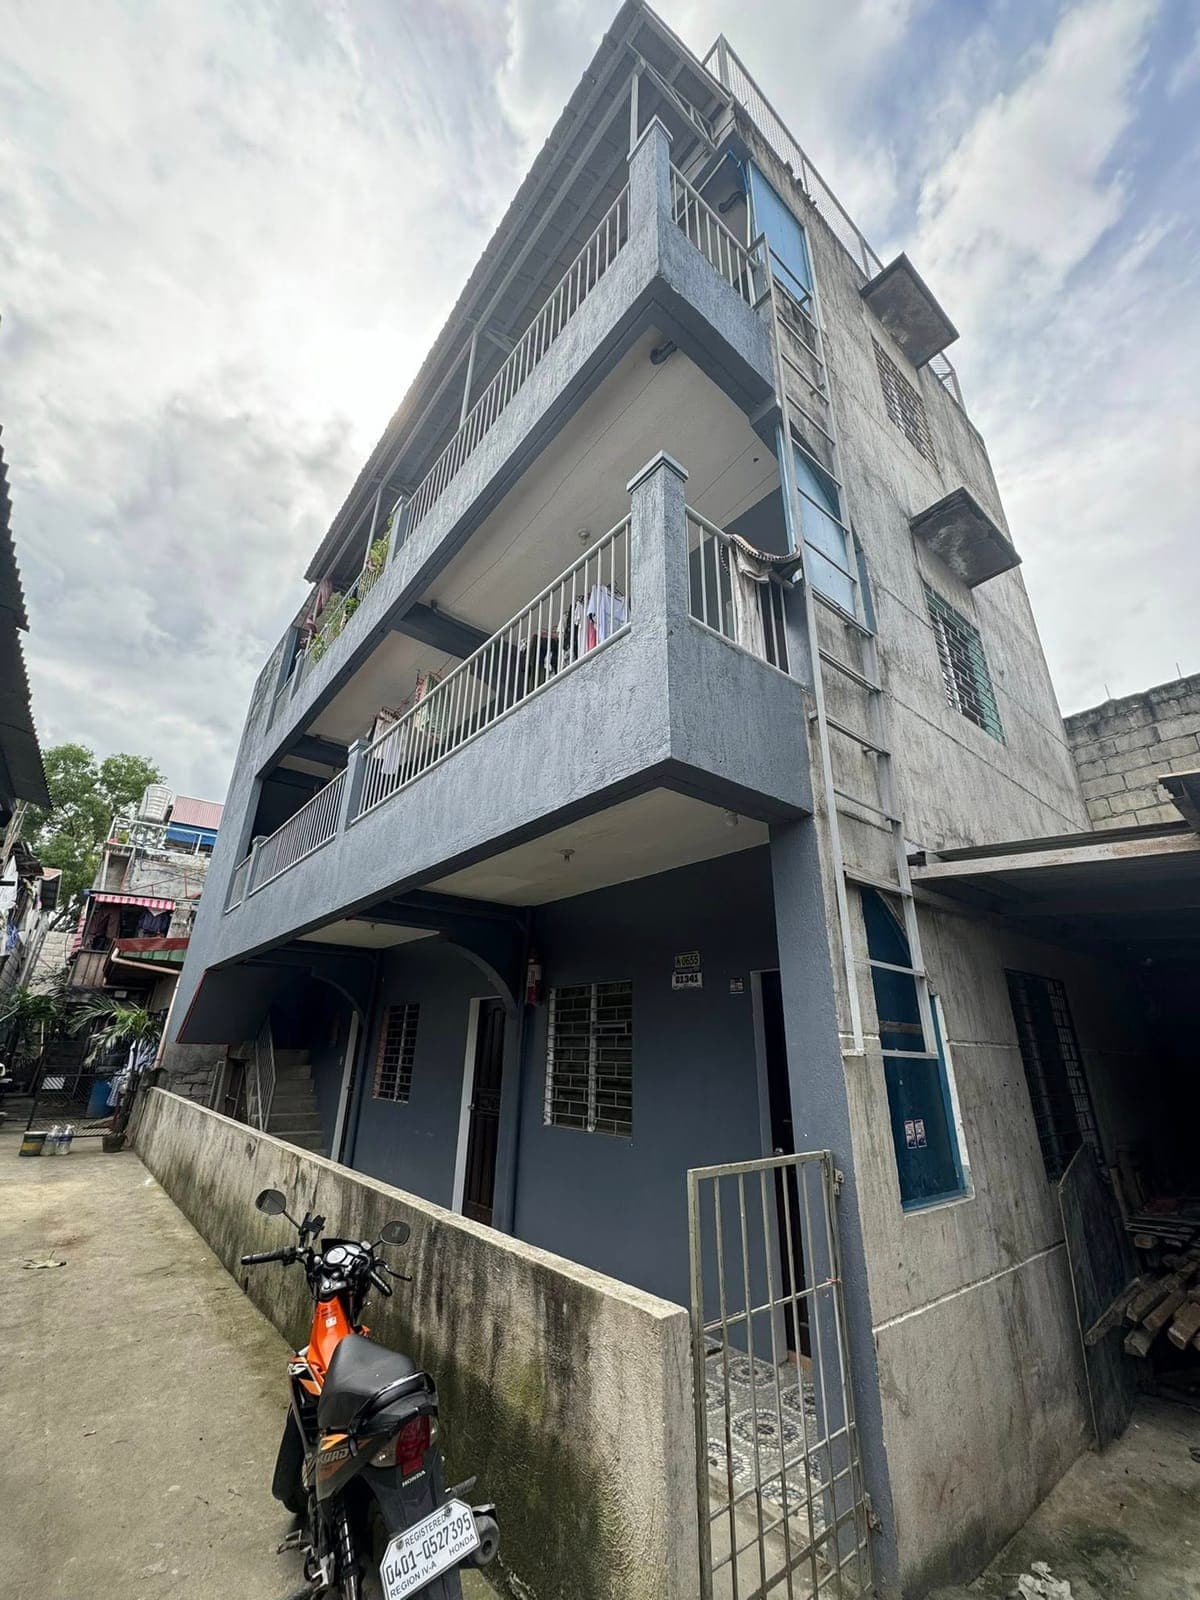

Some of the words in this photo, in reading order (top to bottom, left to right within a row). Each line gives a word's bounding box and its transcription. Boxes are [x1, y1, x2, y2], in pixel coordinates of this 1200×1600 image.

[401, 1469, 426, 1488] HONDA
[404, 1510, 450, 1548] REGISTERED
[448, 1533, 476, 1556] HONDA
[390, 1572, 421, 1598] REGION
[421, 1560, 438, 1577] IV-A
